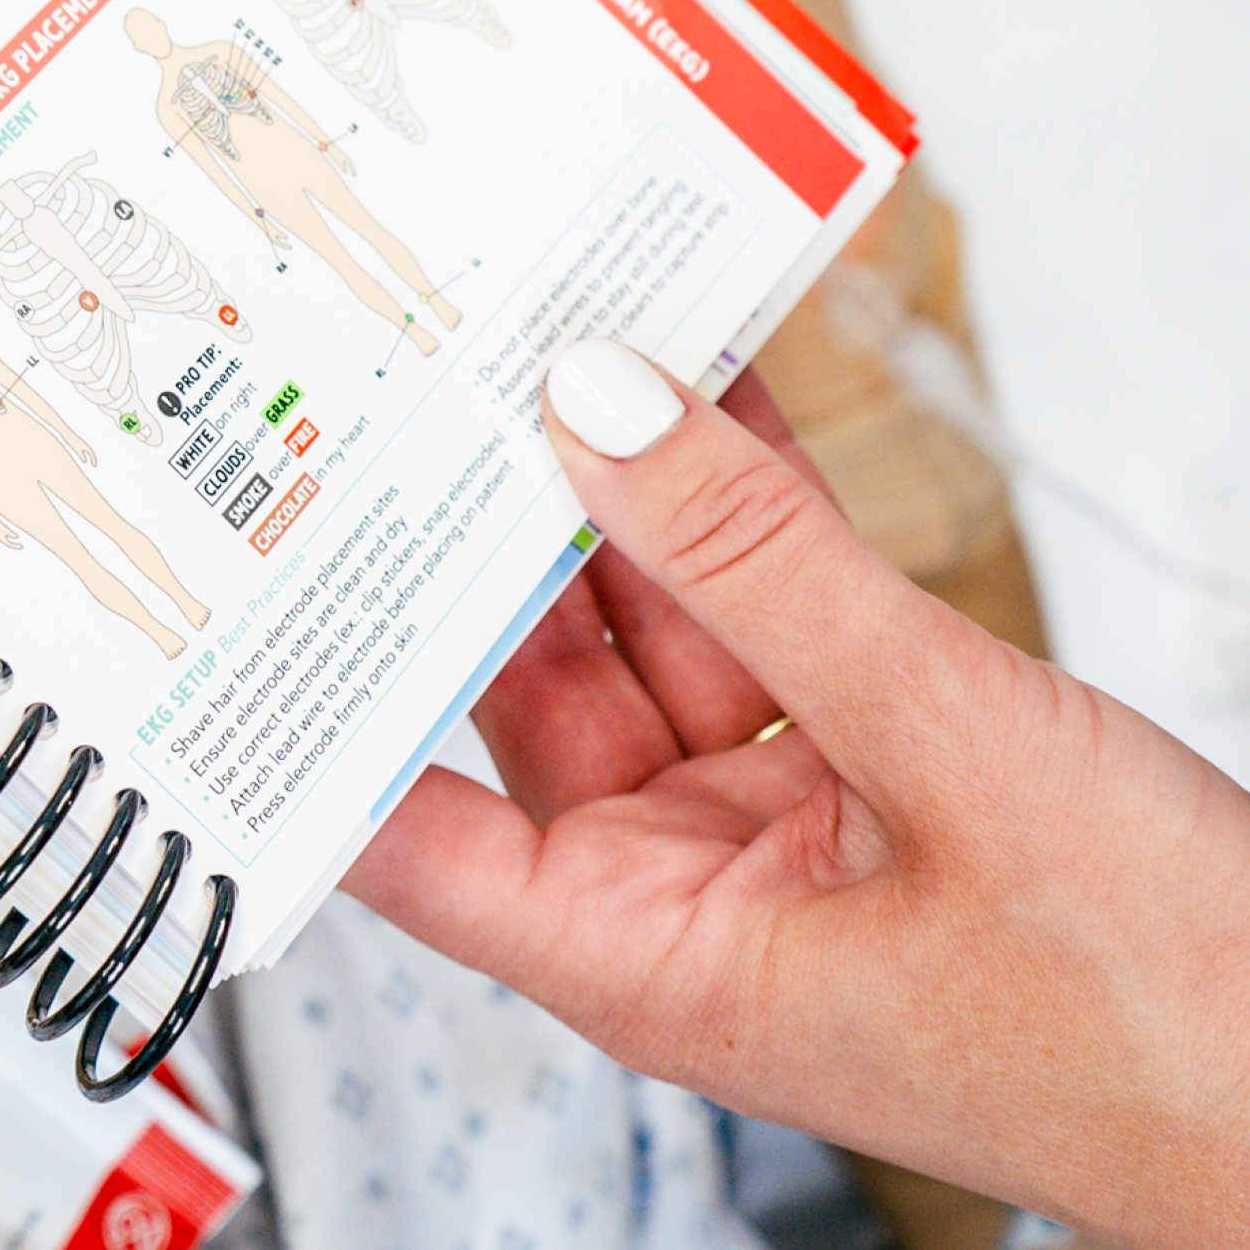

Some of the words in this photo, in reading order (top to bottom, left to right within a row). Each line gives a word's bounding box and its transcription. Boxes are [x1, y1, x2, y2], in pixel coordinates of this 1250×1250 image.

[644, 15, 711, 83] (EKG)
[15, 301, 32, 319] RA
[81, 294, 97, 309] V
[477, 359, 502, 383] Do
[497, 335, 522, 361] not
[517, 300, 552, 341] place
[547, 236, 607, 303] electrodes
[602, 207, 629, 239] over
[623, 174, 659, 210] bone
[495, 355, 537, 400] Assess
[530, 322, 563, 357] lead
[557, 292, 591, 328] wires
[585, 276, 603, 294] to
[599, 228, 644, 282] prevent
[638, 178, 689, 232] tangling
[591, 306, 610, 324] to
[605, 280, 634, 310] stay
[628, 254, 651, 282] still
[647, 215, 689, 260] during
[681, 191, 705, 218] test
[618, 291, 654, 331] clears
[649, 275, 667, 293] to
[663, 229, 706, 279] capture
[25, 354, 39, 368] LL
[174, 365, 201, 395] PRO
[195, 342, 222, 369] TIP:
[220, 306, 237, 323] LL
[121, 415, 139, 432] RL
[175, 428, 214, 471] WHITE
[214, 410, 232, 430] on
[228, 380, 259, 413] right
[178, 356, 243, 426] Placement:
[202, 447, 247, 497] CLOUDS
[241, 421, 271, 452] over
[264, 384, 300, 424] GRASS
[226, 478, 269, 525] SMOKE
[267, 450, 293, 480] over
[287, 421, 319, 455] FIRE
[253, 476, 321, 550] CHOCOLATE
[310, 466, 328, 482] in
[323, 446, 346, 470] my
[337, 413, 371, 449] heart
[134, 702, 175, 746] EKG
[167, 647, 219, 709] SETUP
[215, 614, 252, 654] Best
[244, 549, 307, 618] Practices
[168, 710, 215, 759] Shave
[206, 680, 238, 714] hair
[231, 647, 267, 684] from
[262, 583, 320, 650] electrode
[314, 513, 377, 590] placement
[370, 483, 400, 517] sites
[187, 724, 238, 778] Ensure
[233, 657, 293, 727] electrode
[288, 624, 320, 660] sites
[314, 601, 338, 628] are
[333, 565, 367, 604] clean
[361, 534, 389, 567] and
[383, 514, 409, 541] dry
[207, 764, 240, 796] Use
[236, 711, 283, 766] correct
[276, 640, 340, 715] electrodes
[331, 610, 364, 645] (ex.:
[358, 584, 385, 613] clip
[378, 534, 427, 587] stickers,
[420, 500, 452, 536] snap
[445, 428, 507, 502] electrodes)
[227, 763, 275, 816] Attach
[266, 726, 302, 765] lead
[296, 699, 326, 732] wire
[320, 681, 340, 701] to
[335, 617, 391, 683] electrode
[381, 572, 426, 620] before
[420, 524, 466, 579] placing
[458, 505, 478, 527] on
[473, 458, 516, 512] patient
[245, 790, 286, 833] Press
[281, 723, 340, 793] electrode
[331, 682, 373, 726] firmly
[365, 650, 397, 686] onto
[391, 621, 419, 652] skin
